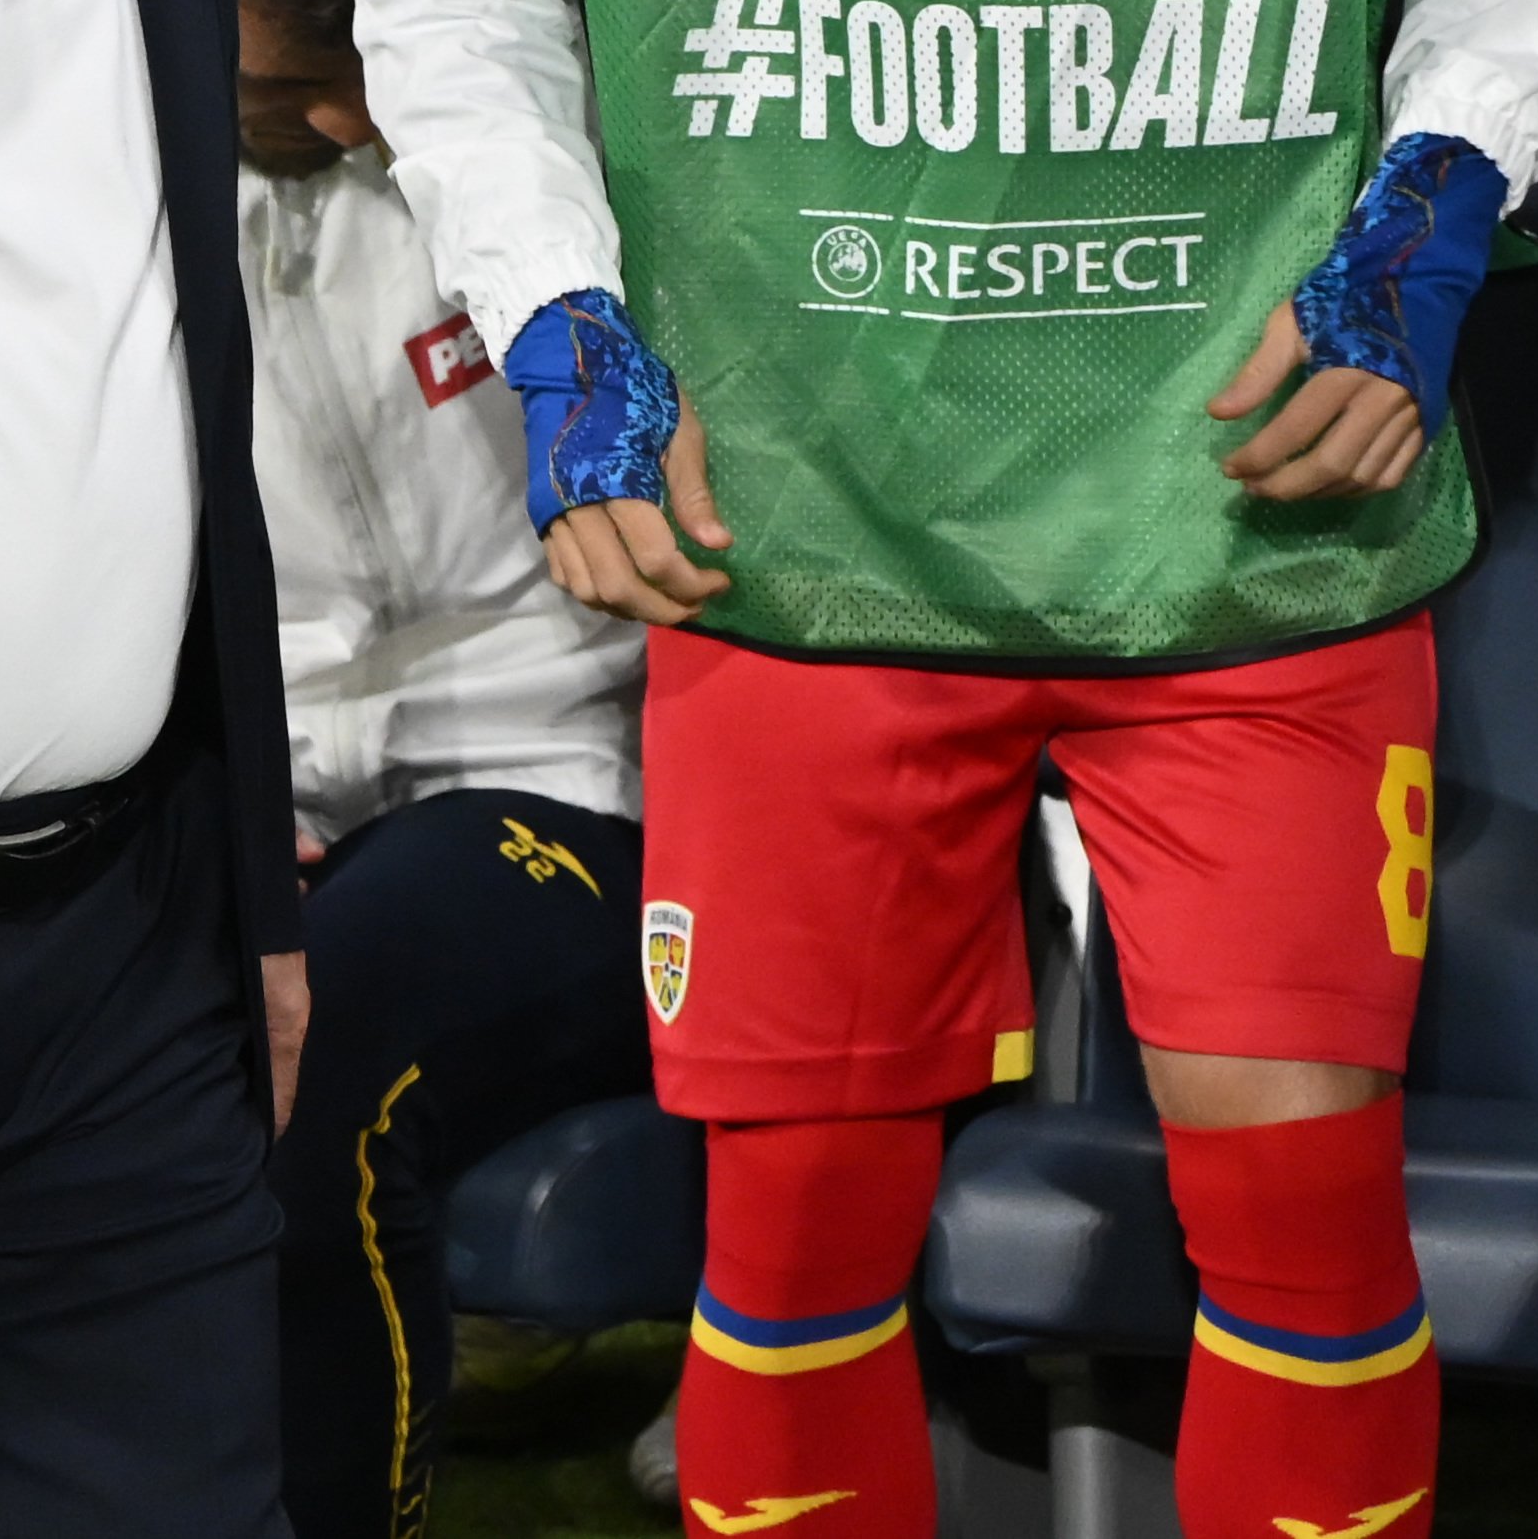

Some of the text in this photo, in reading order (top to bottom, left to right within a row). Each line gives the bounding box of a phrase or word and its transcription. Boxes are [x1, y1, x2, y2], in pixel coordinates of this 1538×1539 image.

[905, 234, 1203, 300] RESPECT
[499, 836, 557, 884] 22
[1376, 744, 1434, 960] 8
